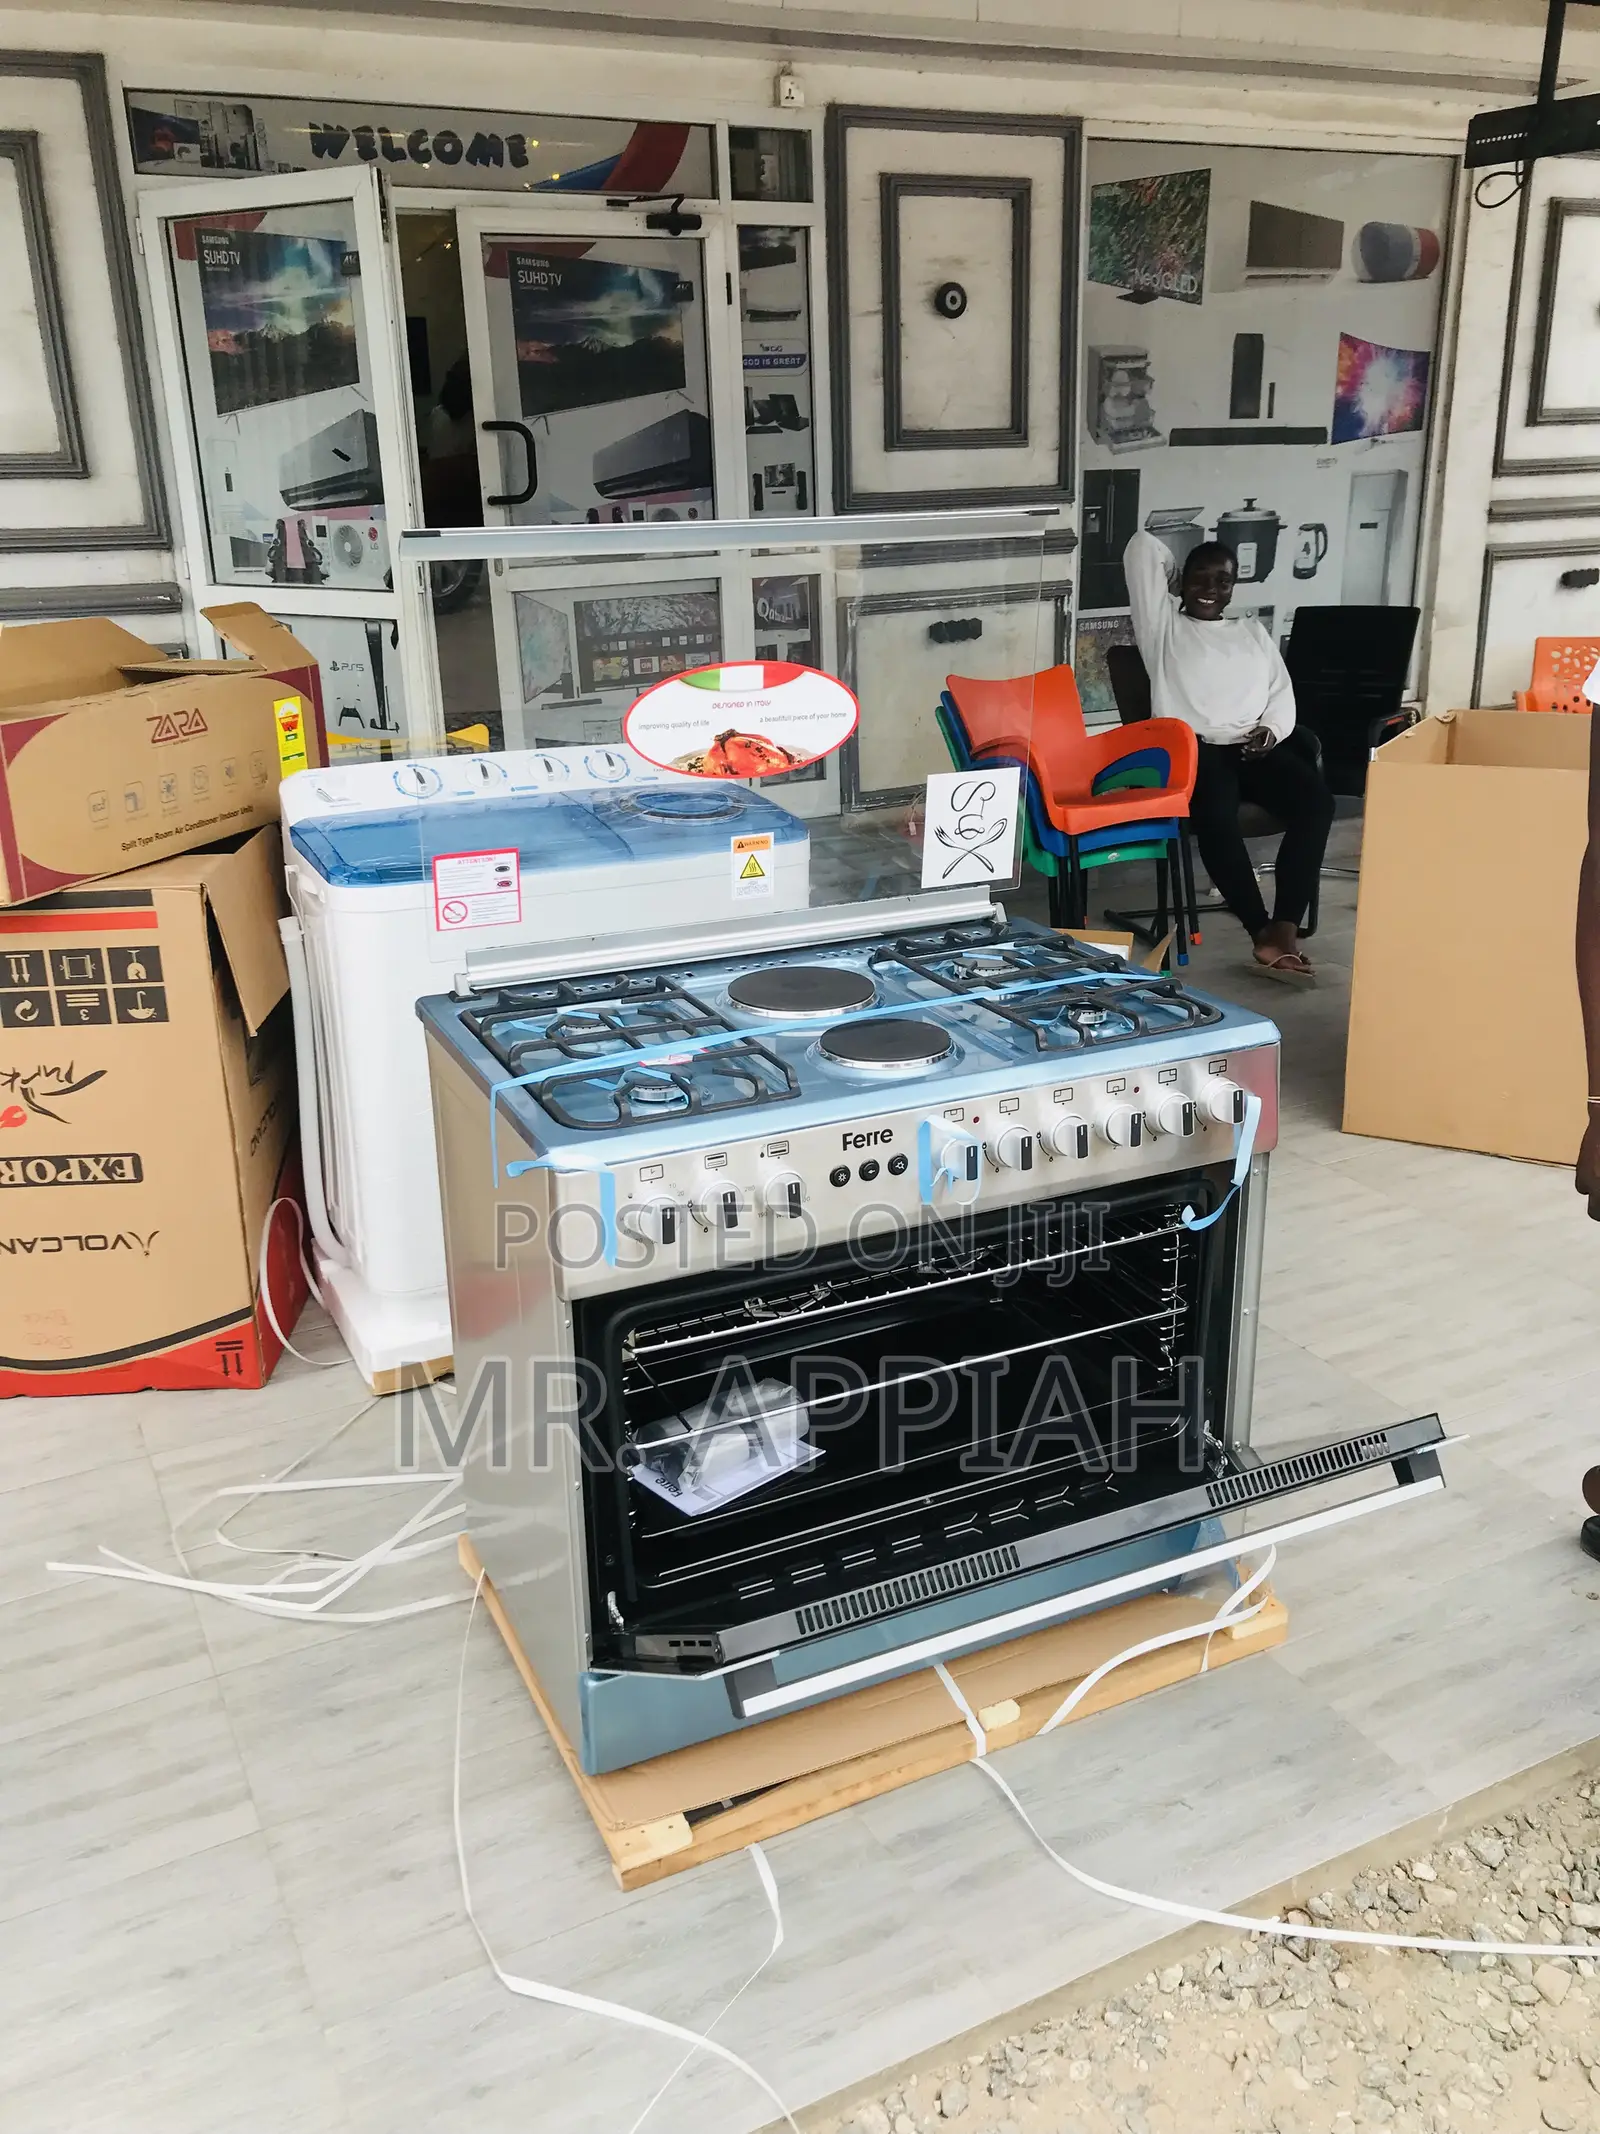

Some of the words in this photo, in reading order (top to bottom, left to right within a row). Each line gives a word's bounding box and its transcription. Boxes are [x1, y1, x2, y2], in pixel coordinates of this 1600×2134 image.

[309, 122, 529, 168] WELCOME
[516, 256, 550, 267] SAMSUNG
[743, 358, 760, 366] GOD
[762, 357, 771, 365] IS
[773, 357, 801, 365] GREAT
[1079, 620, 1119, 631] SAMSUNG
[341, 662, 365, 672] PS5
[792, 714, 808, 723] piece
[809, 712, 816, 720] of
[816, 712, 830, 723] your
[830, 711, 847, 719] home
[638, 722, 670, 731] improving
[671, 720, 691, 729] quality
[692, 719, 699, 727] of
[121, 839, 138, 852] Split
[137, 836, 154, 848] Type
[155, 830, 173, 841] Room
[174, 826, 184, 836] Air
[184, 815, 219, 832] Conditioner
[744, 839, 769, 847] WARNING
[841, 1128, 894, 1152] Ferre
[655, 1477, 684, 1498] Ferre
